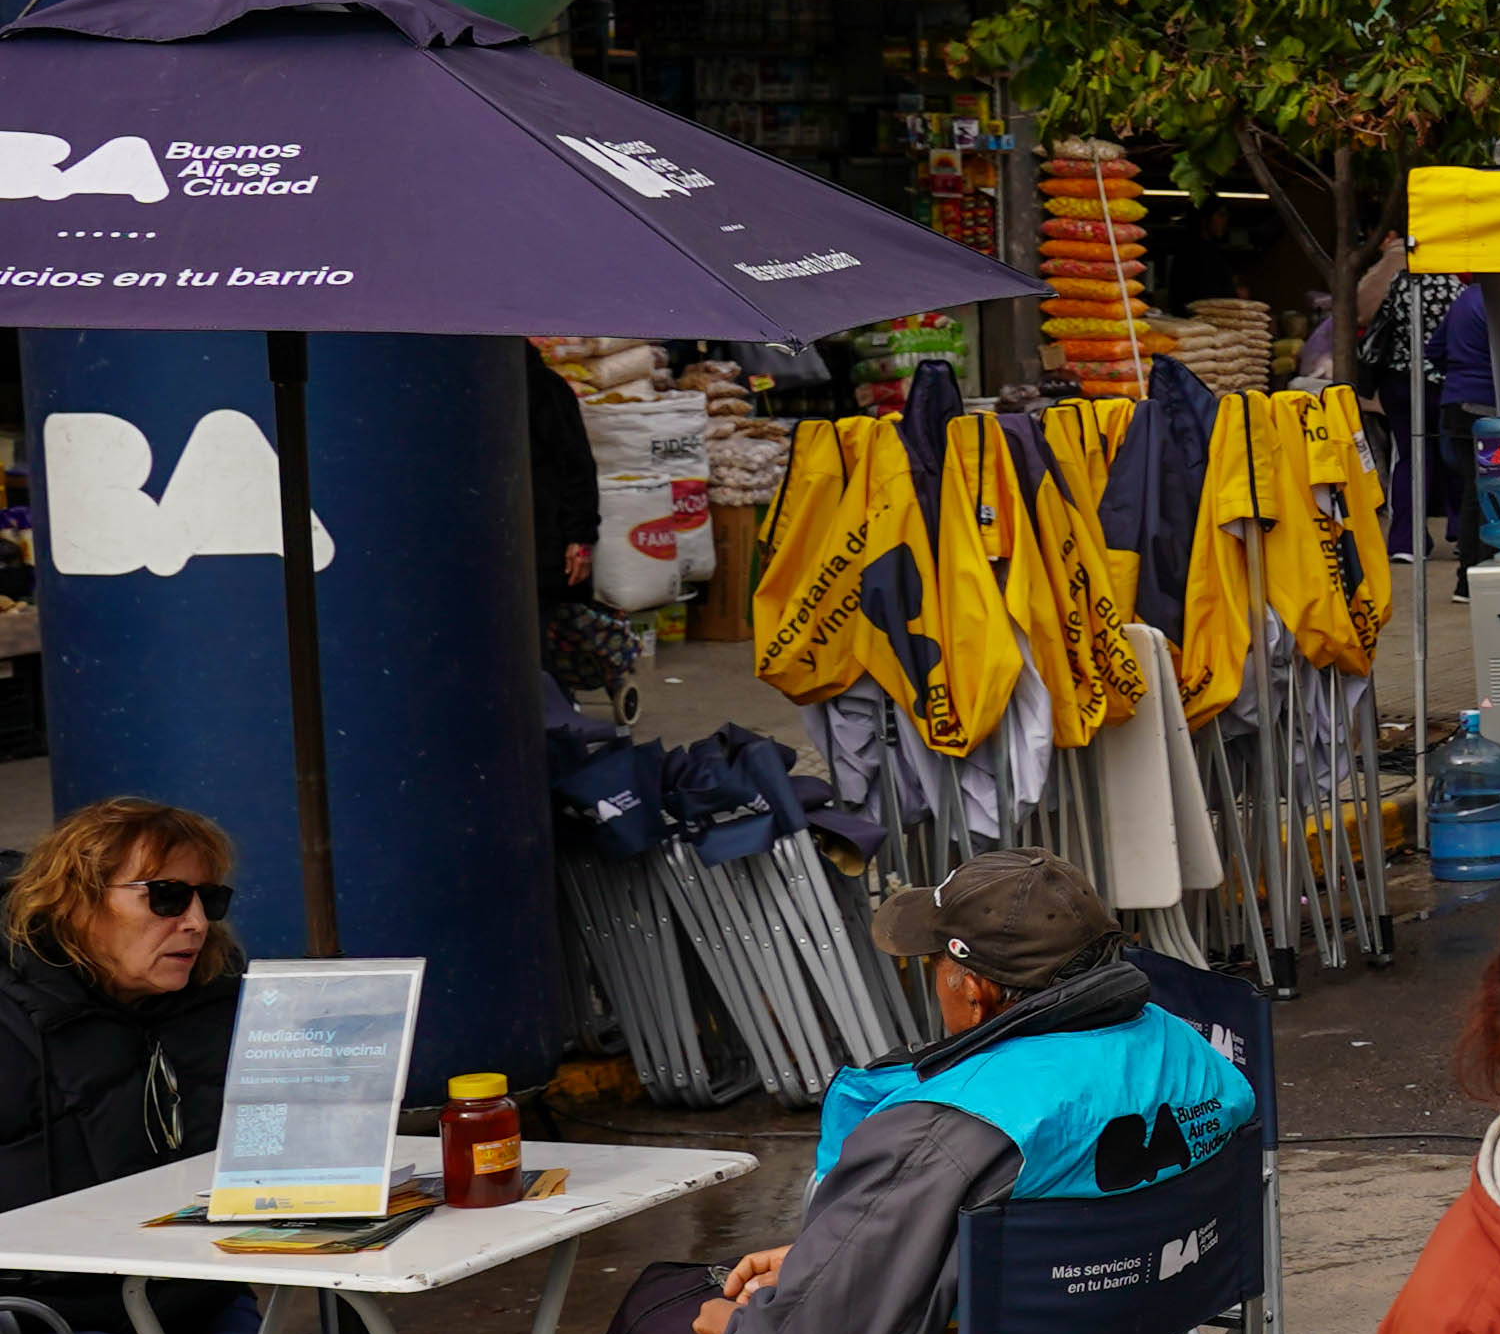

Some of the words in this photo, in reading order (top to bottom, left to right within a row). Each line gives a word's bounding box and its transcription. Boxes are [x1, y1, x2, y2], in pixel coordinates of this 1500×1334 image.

[165, 141, 302, 160] Buenos
[177, 160, 282, 178] Aires
[182, 176, 319, 197] Ciudad
[112, 273, 167, 287] en
[175, 269, 220, 286] tu
[226, 267, 354, 286] barrio
[799, 653, 819, 673] y
[249, 1028, 324, 1043] Mediación
[326, 1030, 337, 1043] y
[245, 1046, 332, 1059] convivencia
[336, 1042, 387, 1057] vecinal
[1176, 1098, 1222, 1124] Buenos
[1189, 1116, 1221, 1142] Aires
[1052, 1264, 1081, 1279] Más
[1084, 1257, 1141, 1275] servicios
[1068, 1281, 1085, 1293] en
[1088, 1277, 1101, 1291] tu
[1104, 1272, 1140, 1290] barrio
